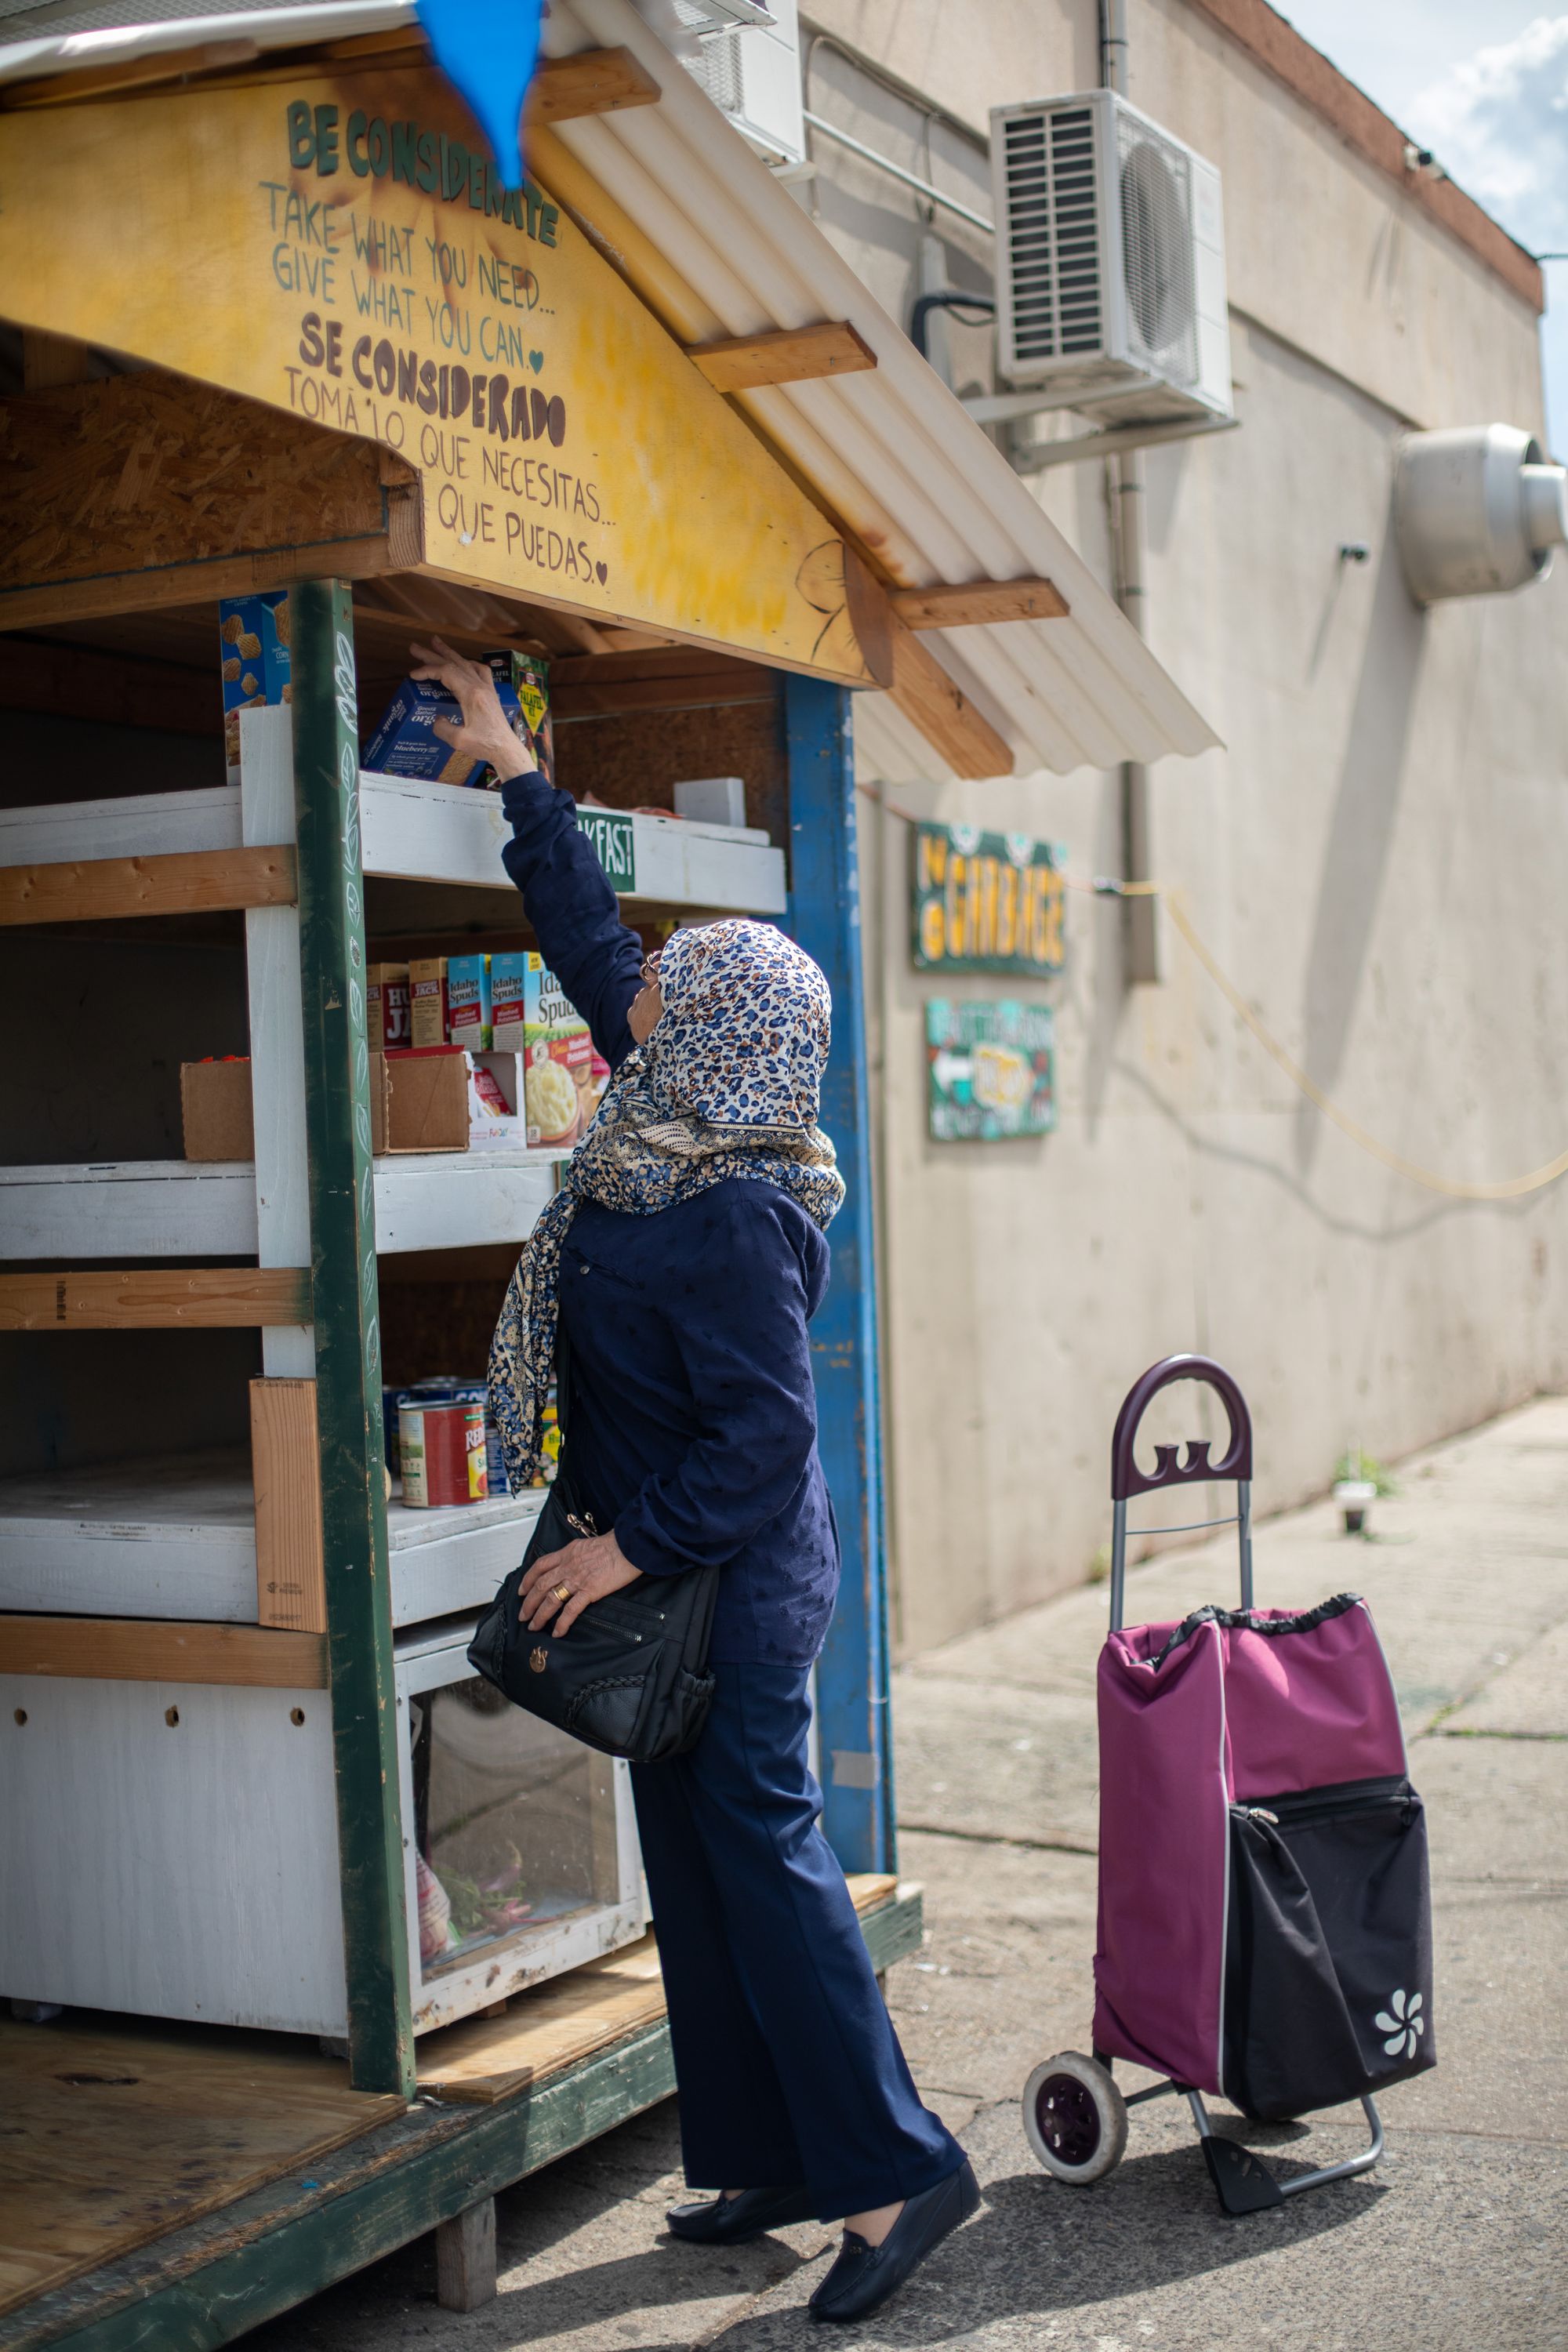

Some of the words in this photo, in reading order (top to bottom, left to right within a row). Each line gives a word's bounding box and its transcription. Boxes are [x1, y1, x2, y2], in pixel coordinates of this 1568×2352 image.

[287, 100, 339, 178] BE
[258, 180, 340, 255] TAKE
[350, 212, 415, 277] WHAT
[425, 236, 467, 289] YOU
[478, 254, 555, 315] NEED...
[271, 241, 336, 305] GIVE
[350, 269, 416, 336] WHAT
[425, 296, 471, 356] YOU
[299, 312, 344, 377] SE
[351, 333, 567, 448] CONSIDERADO
[420, 423, 471, 479] QUE
[481, 446, 617, 526] NECESITAS...
[438, 483, 496, 543] QUE
[492, 669, 510, 678] LAFEL
[519, 689, 544, 711] FALAFEL
[411, 714, 463, 726] orgic
[394, 745, 428, 754] blueberry
[577, 818, 633, 876] KFAST
[414, 985, 439, 997] JACK
[450, 978, 479, 992] Idaho
[492, 976, 522, 989] Idaho
[492, 985, 522, 1001] Spuds
[538, 971, 562, 996] Ida
[450, 988, 479, 1004] Spuds
[538, 998, 576, 1029] Spud
